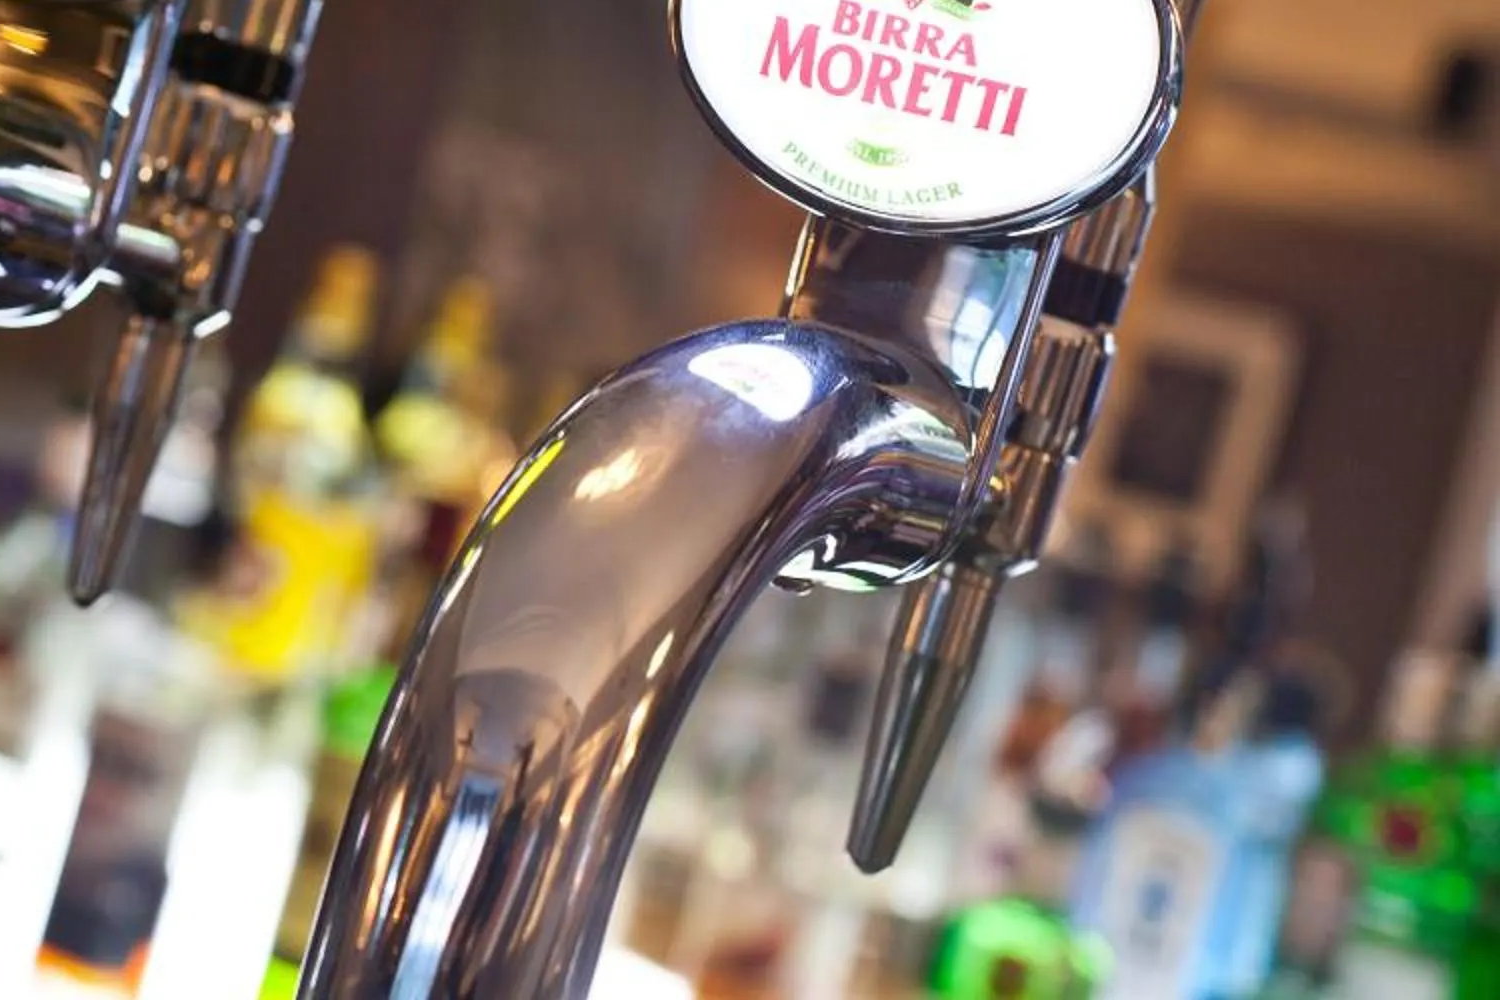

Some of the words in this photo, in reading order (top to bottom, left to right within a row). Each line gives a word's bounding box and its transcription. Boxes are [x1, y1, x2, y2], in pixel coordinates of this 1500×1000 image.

[758, 16, 1028, 137] MORETTI
[782, 141, 879, 203] PREMIUM
[887, 181, 965, 205] LAGER
